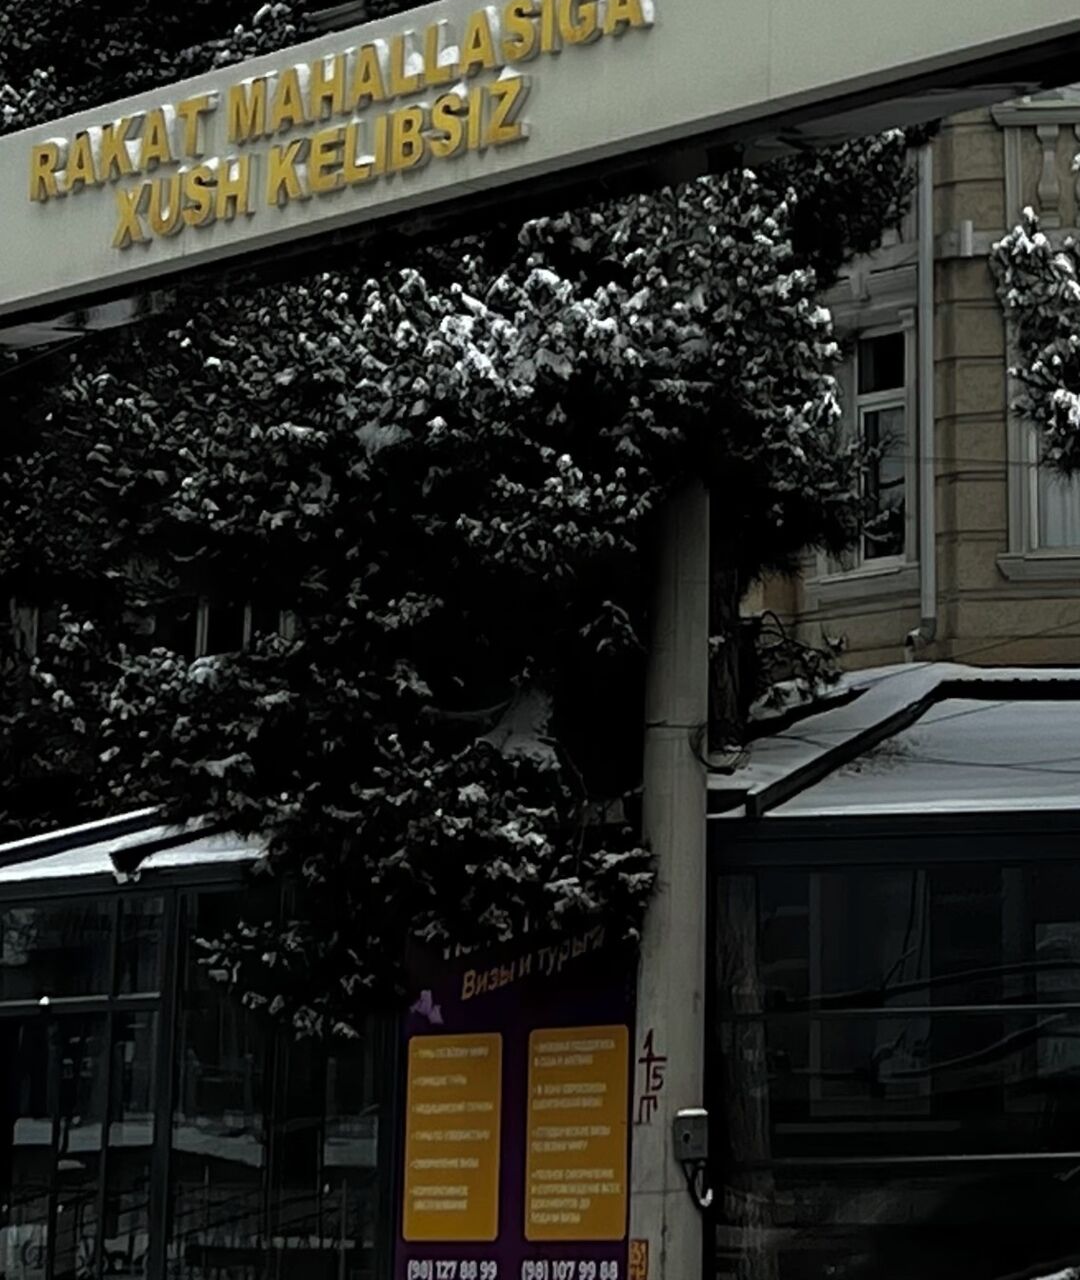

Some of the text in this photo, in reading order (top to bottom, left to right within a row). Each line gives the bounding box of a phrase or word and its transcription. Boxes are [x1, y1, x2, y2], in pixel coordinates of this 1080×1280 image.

[28, 90, 219, 203] RAKAT
[112, 67, 530, 249] XUSH KELIBSIZ
[460, 951, 515, 1001] Визы
